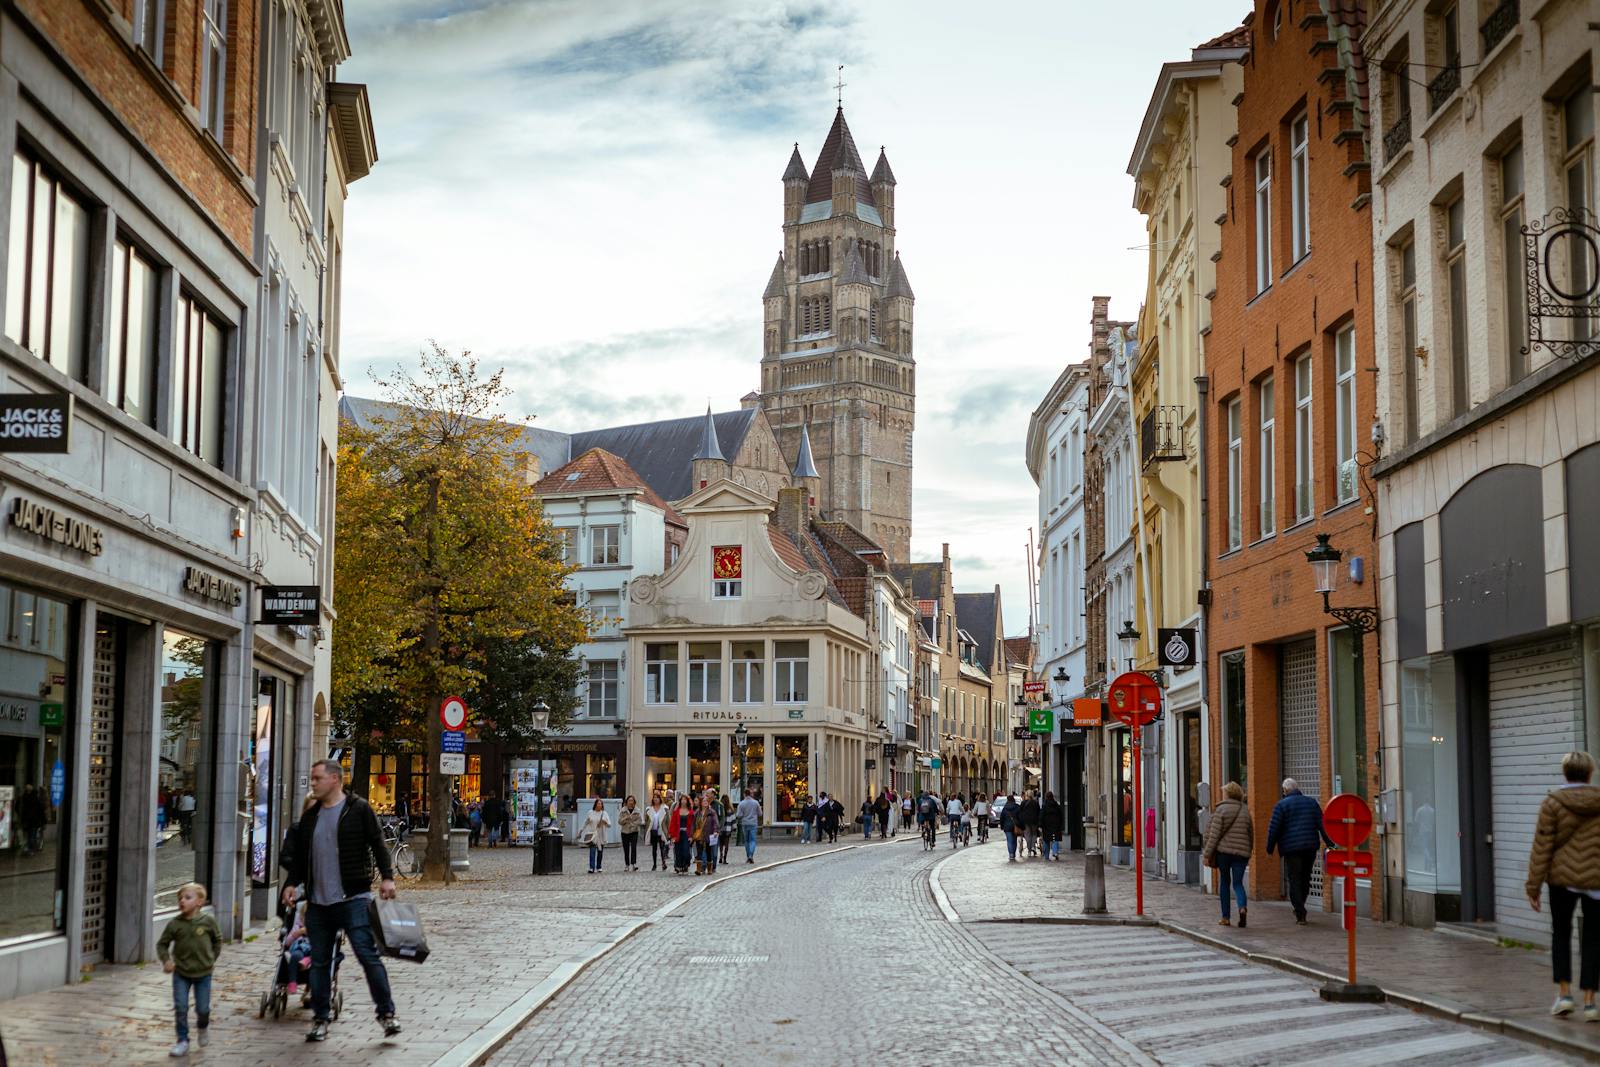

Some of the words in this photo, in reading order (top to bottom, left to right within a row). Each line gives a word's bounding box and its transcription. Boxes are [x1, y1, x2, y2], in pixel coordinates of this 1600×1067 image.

[0, 423, 62, 438] JONES
[264, 599, 287, 610] WAM
[287, 599, 316, 610] DENIM
[1075, 718, 1099, 726] orange
